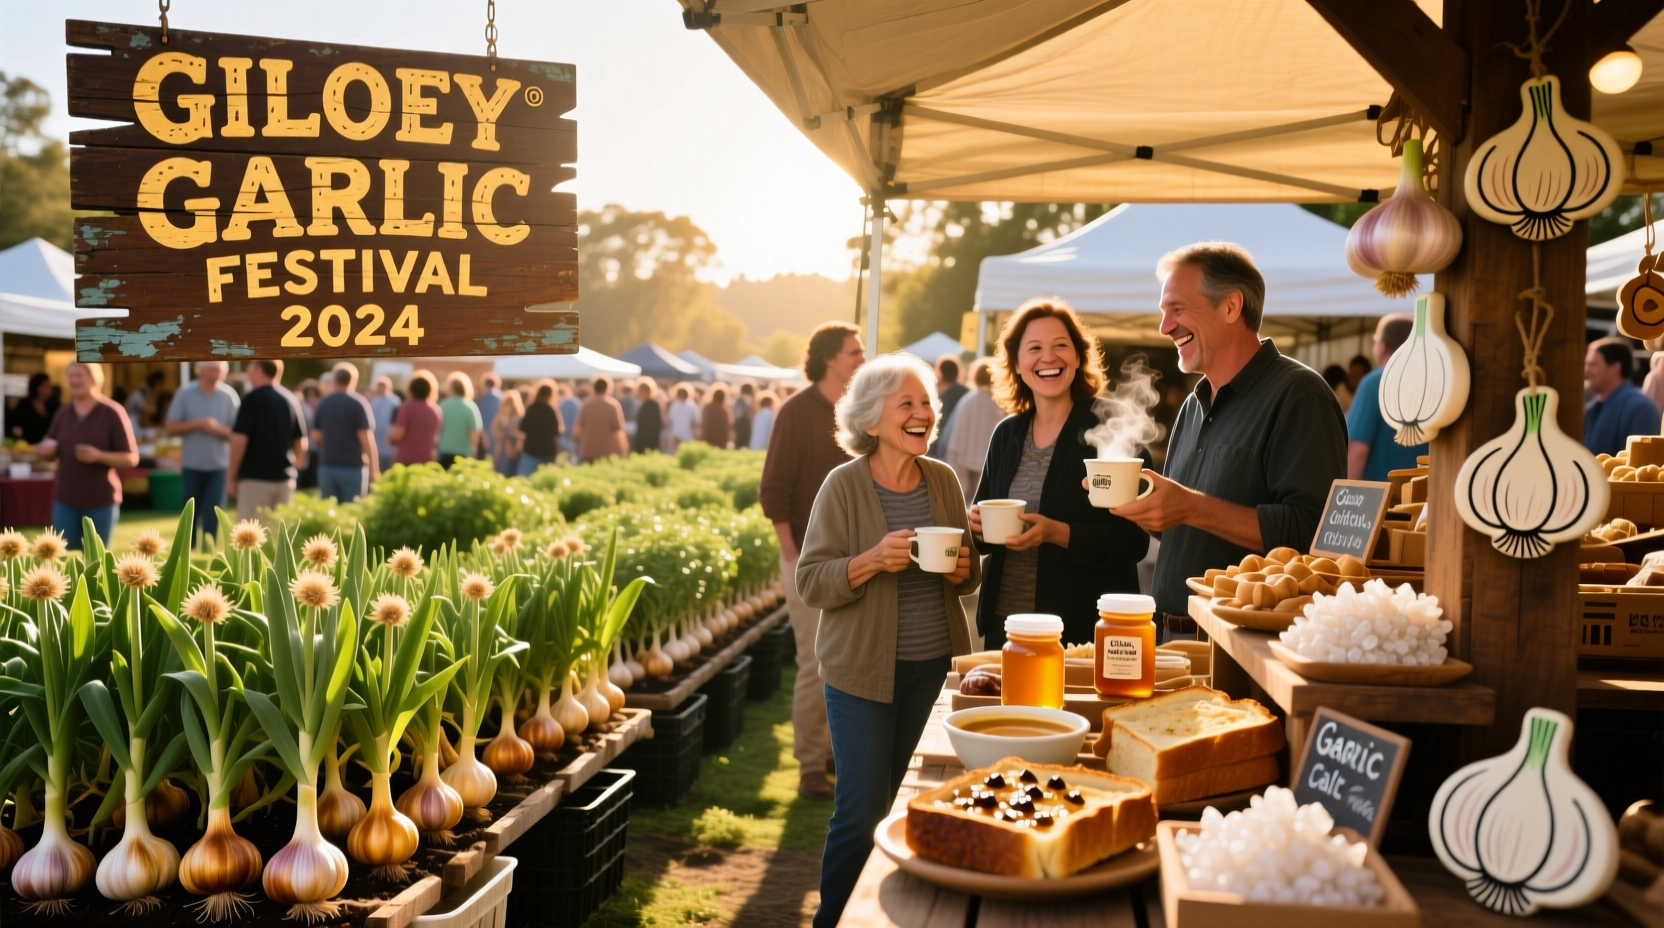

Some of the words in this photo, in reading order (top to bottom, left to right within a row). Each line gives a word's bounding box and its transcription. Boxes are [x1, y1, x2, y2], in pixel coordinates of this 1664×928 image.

[133, 51, 521, 151] GILOEY
[137, 156, 531, 249] GARLIC
[206, 249, 488, 302] FESTIVAL
[280, 304, 425, 347] 2024
